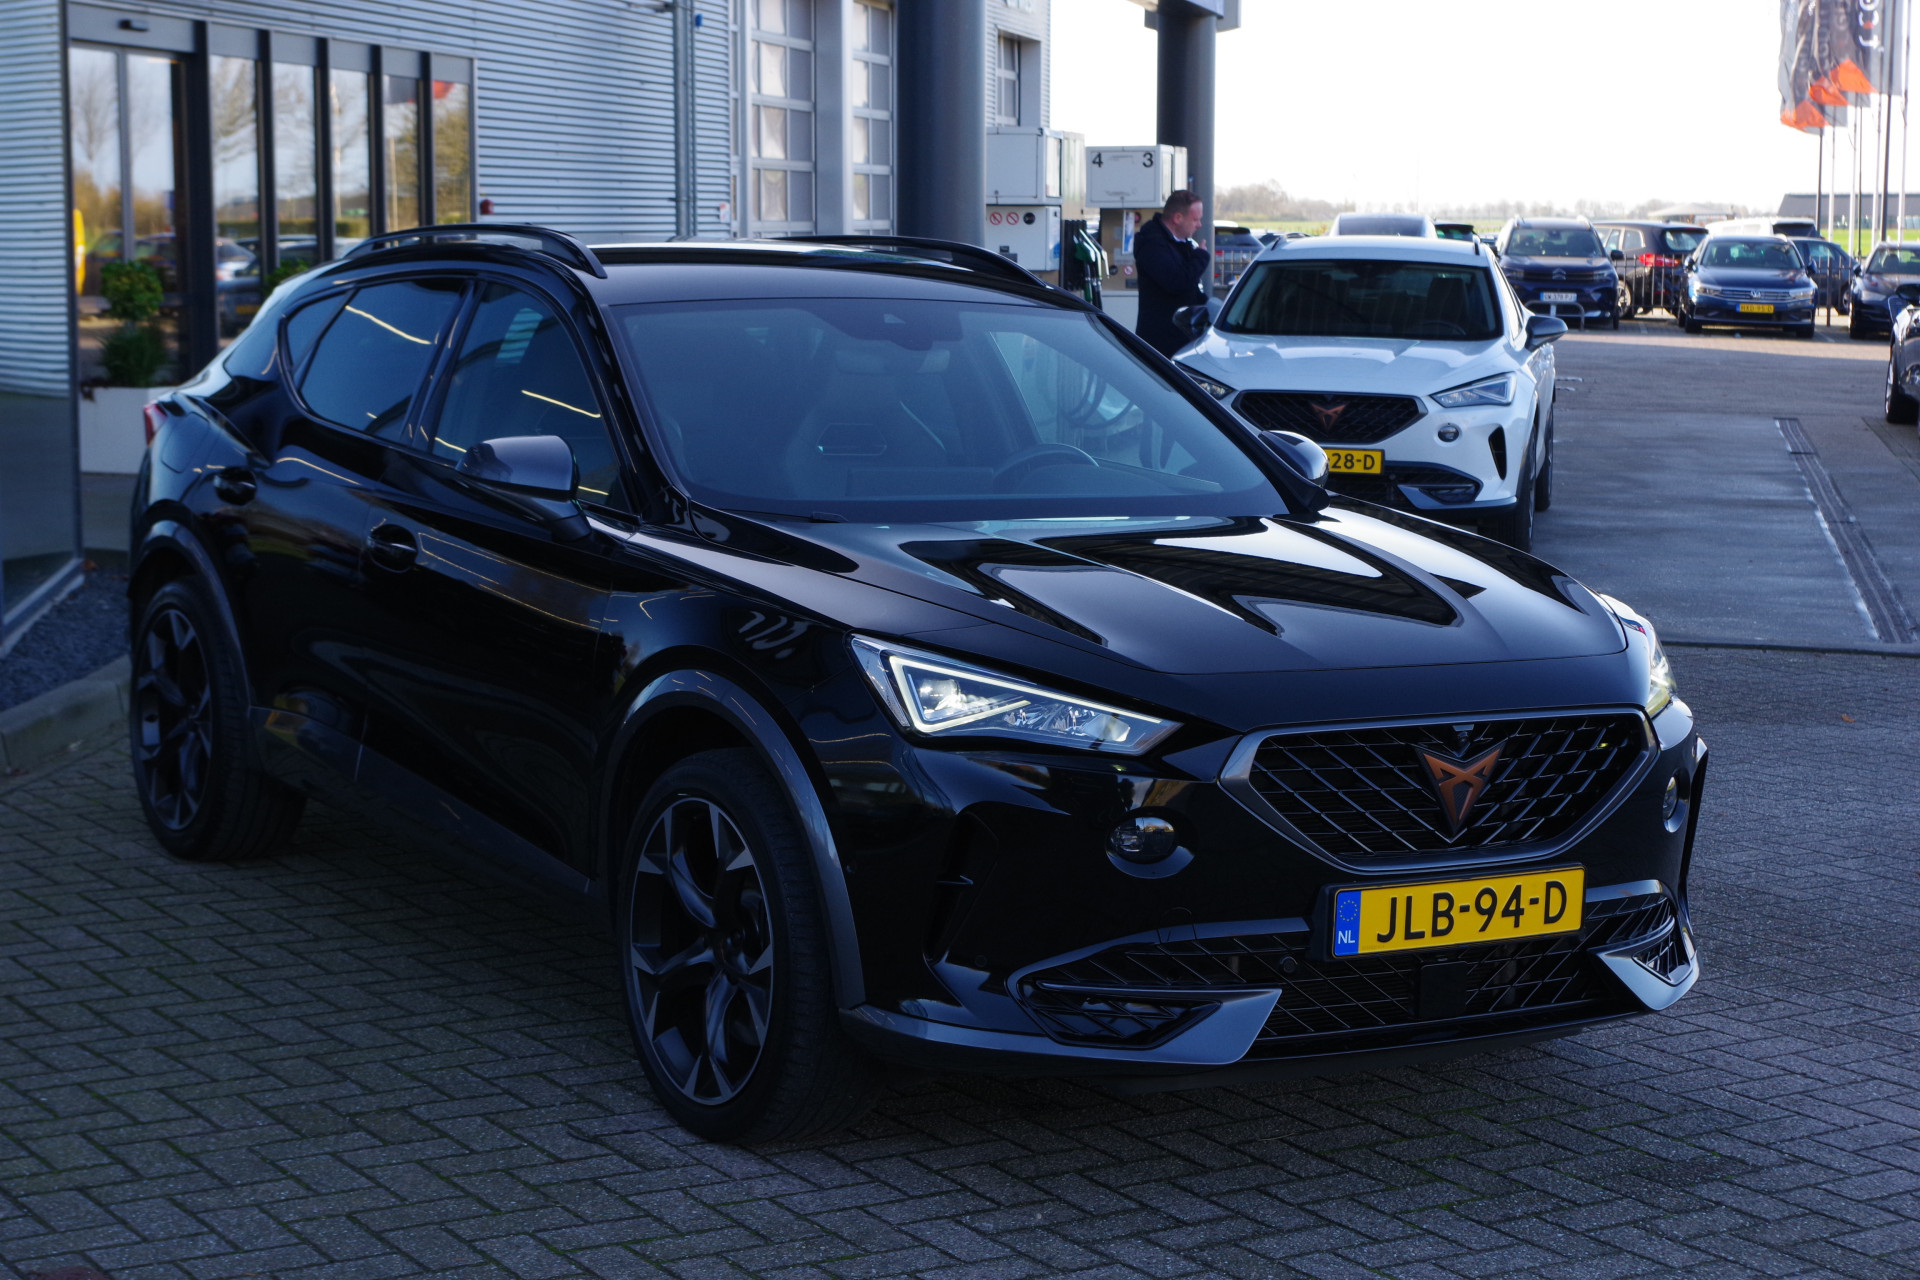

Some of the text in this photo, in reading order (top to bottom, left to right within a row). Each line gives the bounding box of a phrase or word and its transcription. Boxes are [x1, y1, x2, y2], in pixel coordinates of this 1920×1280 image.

[1092, 152, 1104, 168] 4
[1142, 152, 1154, 168] 3
[1377, 880, 1568, 943] JLB-94-D
[1338, 930, 1356, 944] NL
